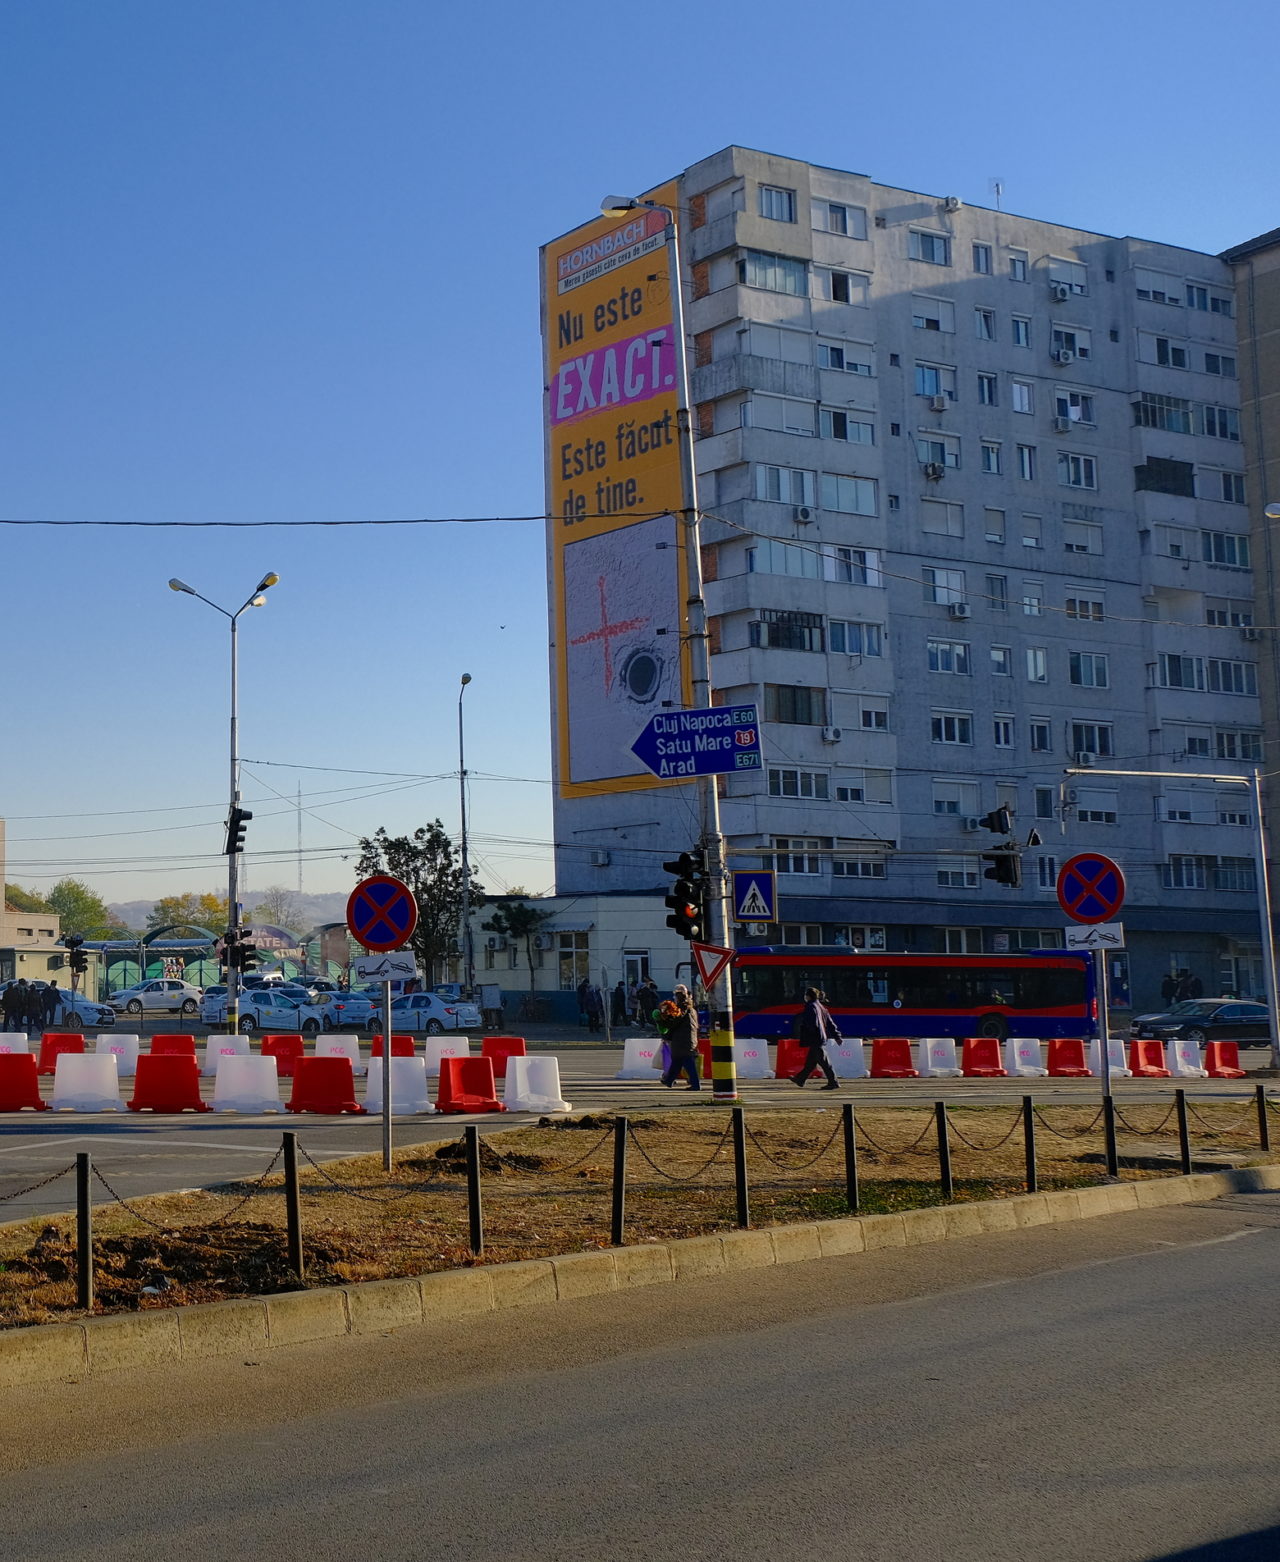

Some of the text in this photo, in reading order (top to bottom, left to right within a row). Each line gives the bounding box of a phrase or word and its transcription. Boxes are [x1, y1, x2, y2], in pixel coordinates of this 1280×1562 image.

[560, 219, 645, 275] HORNBACH
[558, 286, 642, 349] Nu este
[556, 329, 674, 419] EXACT.
[561, 409, 673, 480] Este făcut
[563, 476, 644, 526] de tine.
[653, 713, 732, 734] Cluj Napoca
[733, 710, 754, 723] E60
[656, 734, 732, 755] Satu Mare
[740, 733, 750, 744] 19
[660, 756, 696, 776] Arad
[736, 753, 759, 766] E671
